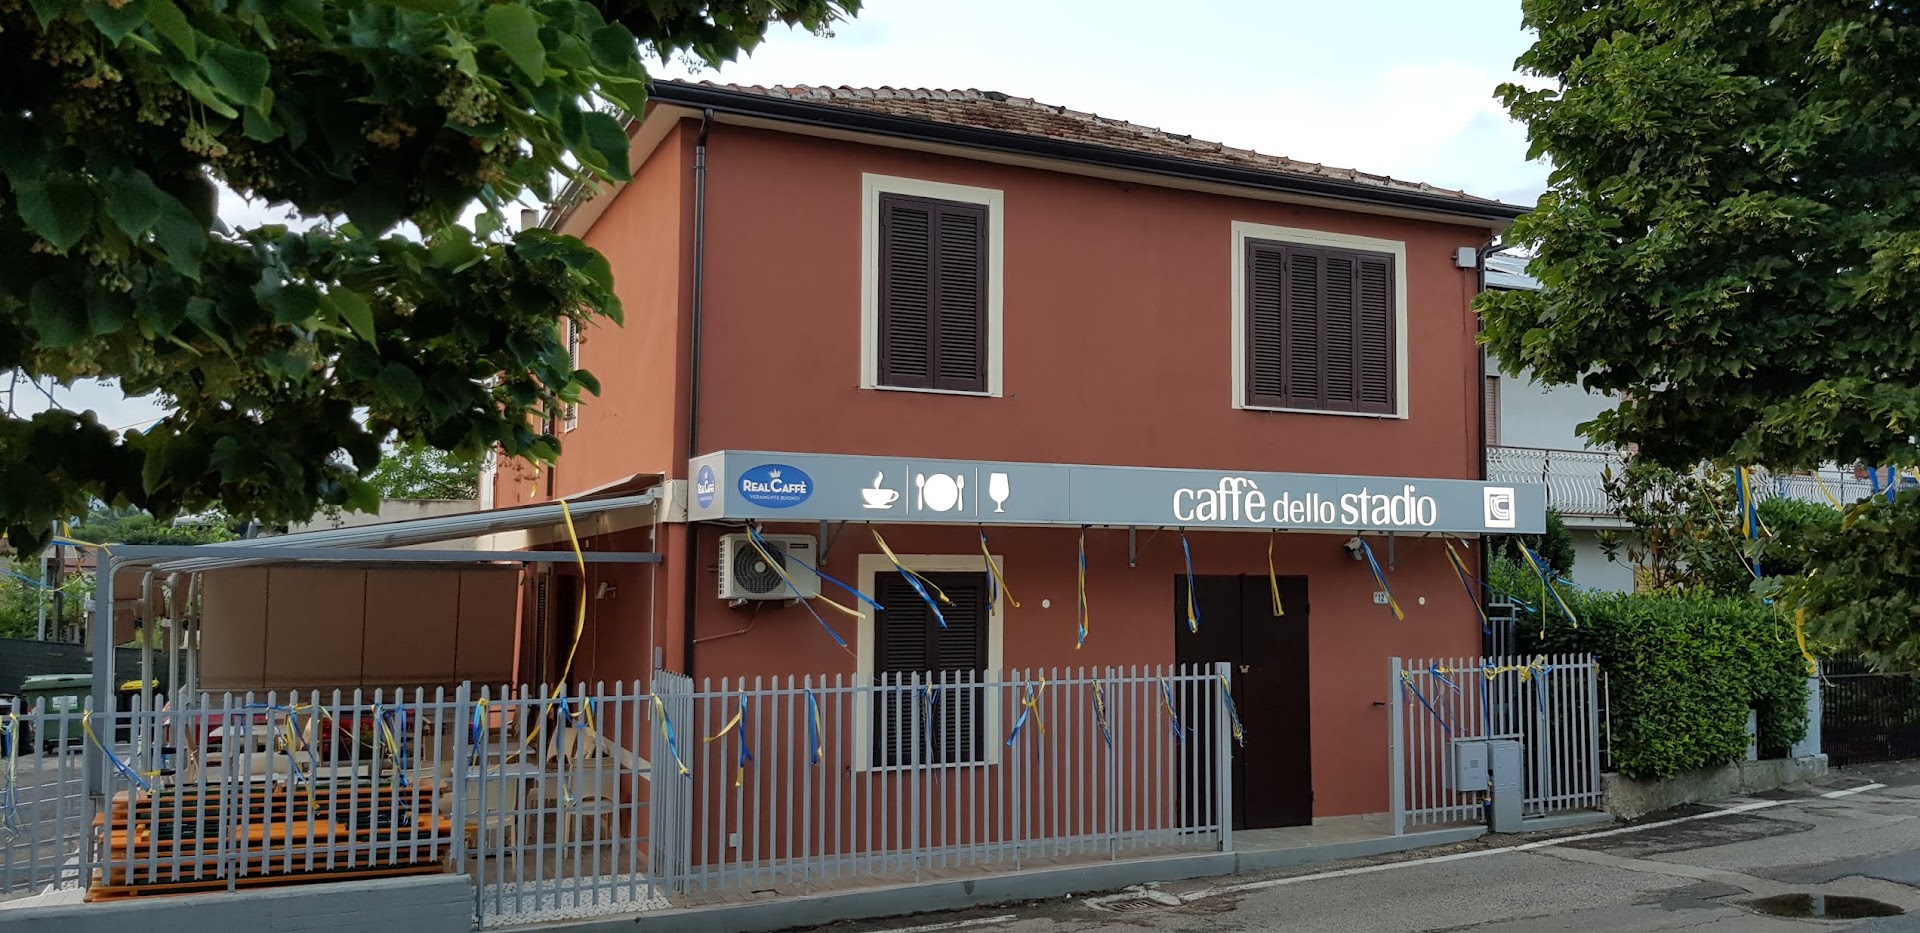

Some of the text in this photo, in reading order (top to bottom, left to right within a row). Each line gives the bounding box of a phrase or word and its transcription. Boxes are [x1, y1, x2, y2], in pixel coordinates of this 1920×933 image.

[1173, 476, 1437, 527] caffè dello stadio
